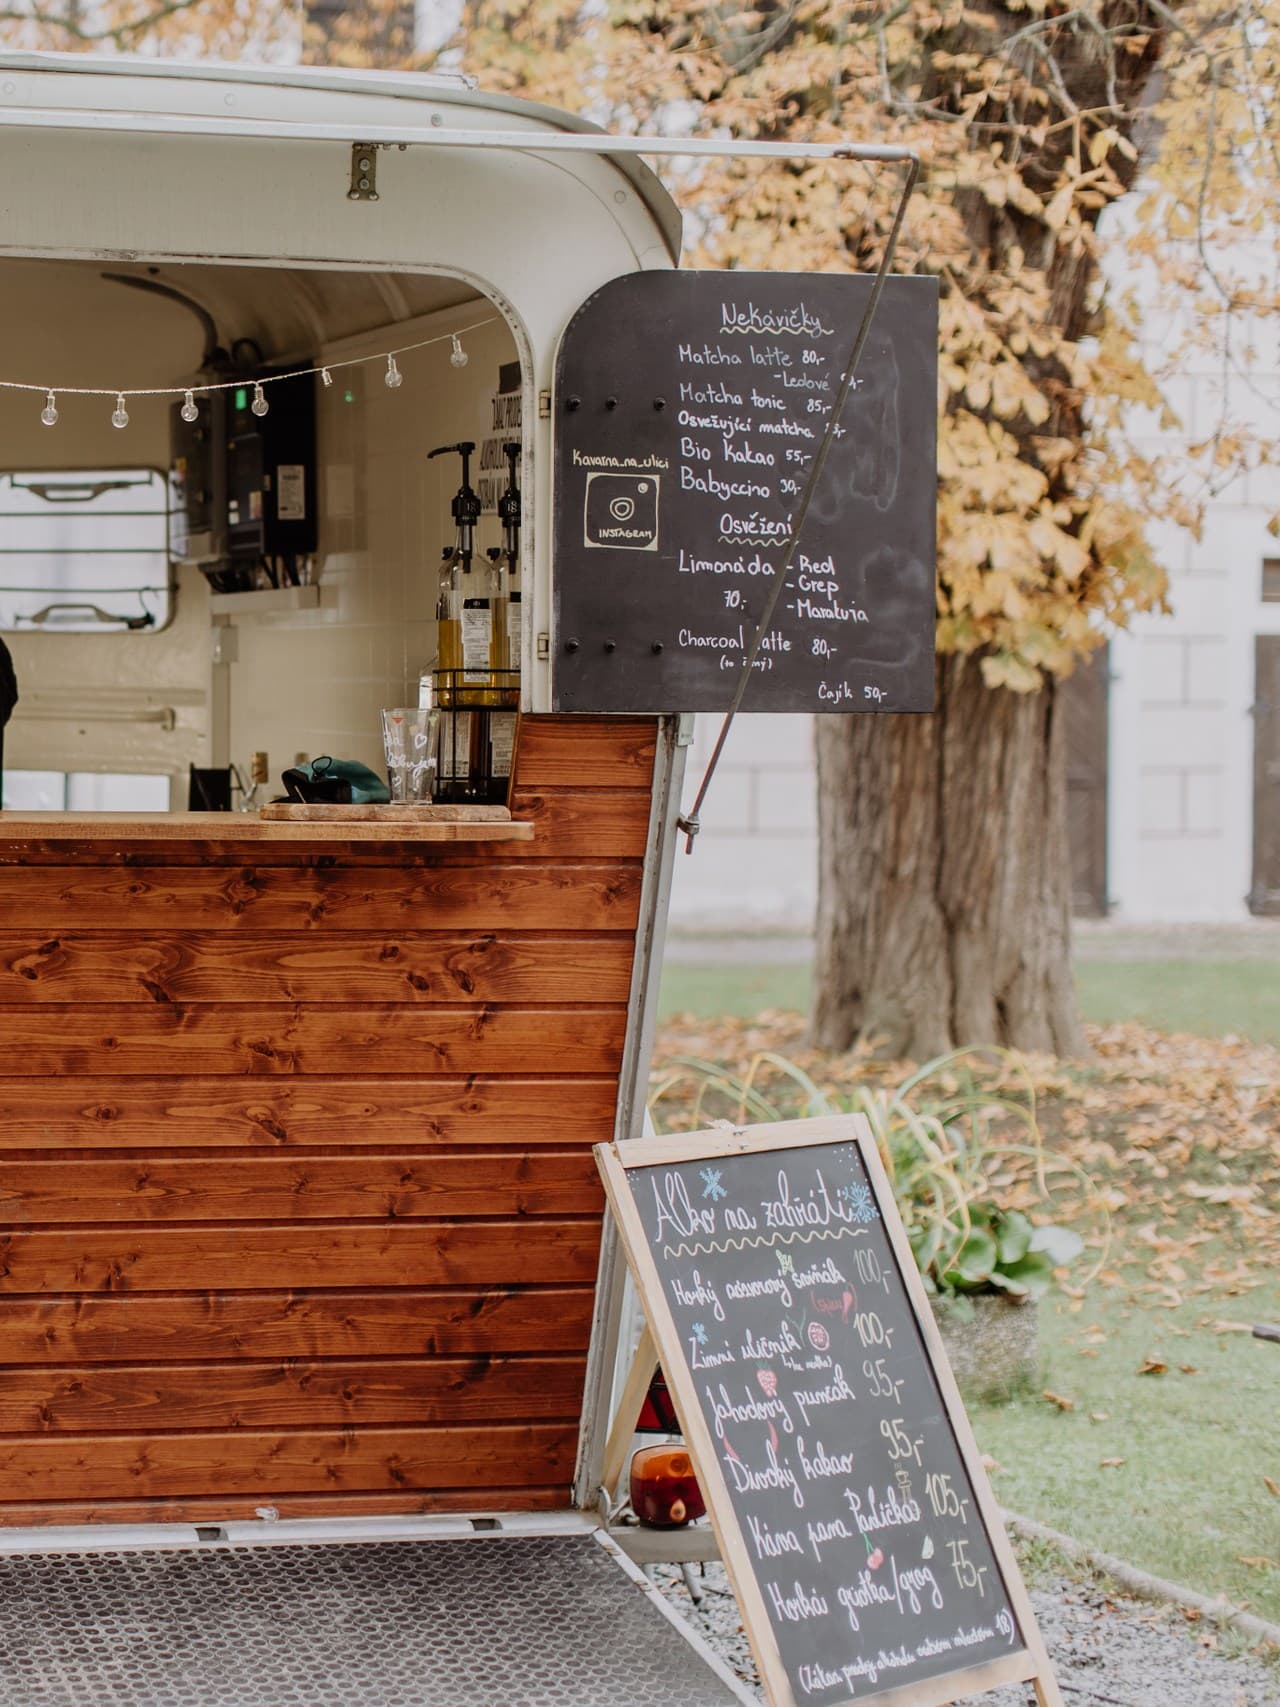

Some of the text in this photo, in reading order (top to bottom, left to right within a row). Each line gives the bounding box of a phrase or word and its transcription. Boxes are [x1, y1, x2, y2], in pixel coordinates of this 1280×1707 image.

[678, 343, 825, 367] Matcha latte 80,-
[679, 382, 833, 414] Matcha tonic 85,-
[759, 418, 816, 438] matcha
[680, 437, 813, 466] Bio kakao 55,-
[680, 465, 802, 501] Babyccino 30,-
[599, 528, 652, 539] INSTAGRAM
[720, 511, 793, 535] Osvěžení
[678, 549, 776, 576] Limonáda
[678, 624, 838, 659] Charcoal atte 80,-
[863, 686, 888, 703] 50,-
[651, 1171, 716, 1243] Alko
[724, 1207, 757, 1231] na
[853, 1248, 892, 1295] 100,-
[853, 1312, 894, 1349] 100,-
[862, 1359, 905, 1405] 95,-
[797, 1436, 854, 1480] kakao
[880, 1418, 924, 1467] 95,-
[747, 1514, 804, 1560] Káva
[807, 1519, 853, 1563] pana
[925, 1472, 969, 1525] 105,-
[946, 1539, 988, 1598] 75,-
